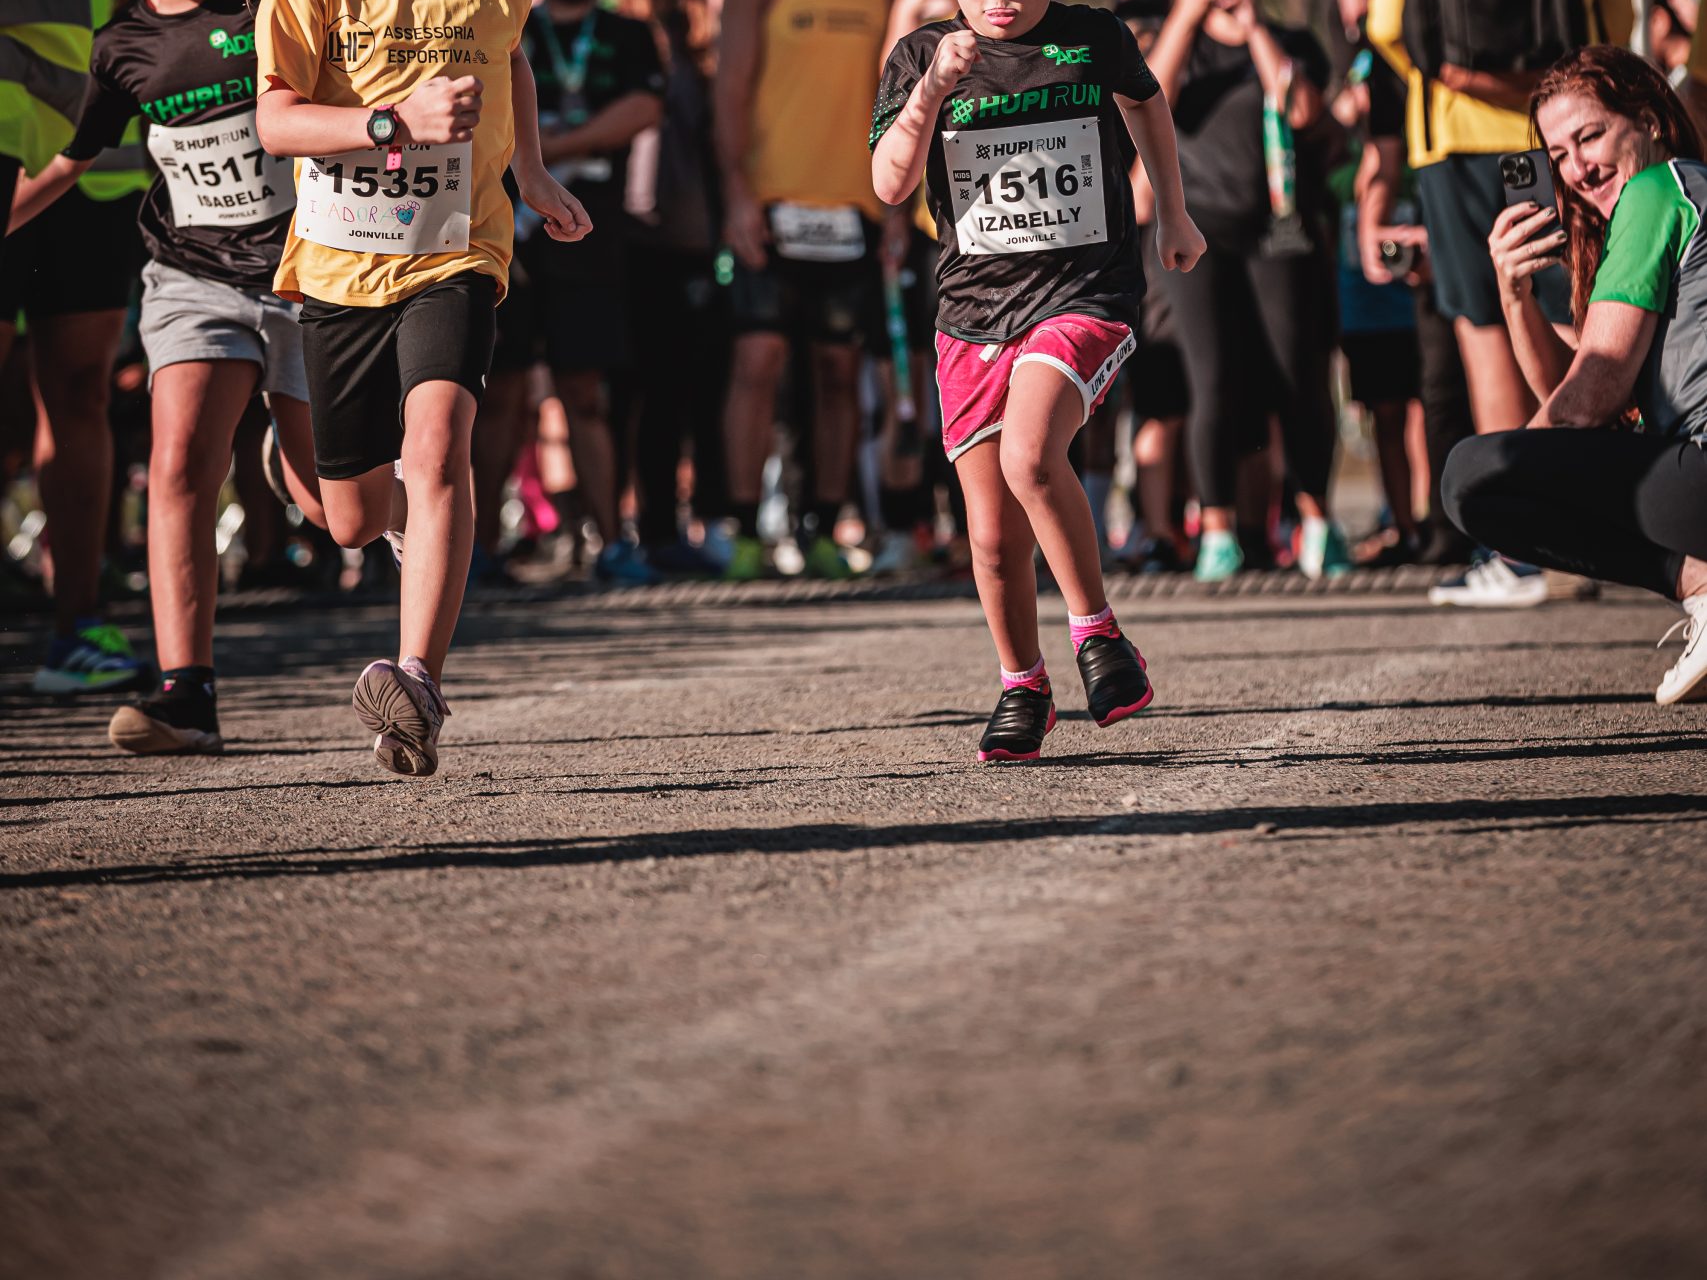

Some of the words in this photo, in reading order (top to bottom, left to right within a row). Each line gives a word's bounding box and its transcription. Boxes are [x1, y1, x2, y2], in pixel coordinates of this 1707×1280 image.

[383, 26, 475, 41] ASSESSORIA
[387, 49, 471, 64] ESPORTIVA
[1044, 44, 1059, 56] 50
[1055, 47, 1093, 65] ADE
[154, 82, 225, 121] HUPI
[979, 88, 1049, 118] HUPI
[1055, 84, 1101, 108] RUN
[187, 135, 220, 151] HUPI
[222, 127, 251, 144] RUN
[993, 140, 1034, 157] HUPI
[1036, 136, 1067, 152] RUN
[182, 148, 267, 187] 1517
[954, 171, 971, 180] KIDS
[326, 162, 439, 199] 1535
[974, 163, 1079, 205] 1516
[198, 184, 276, 208] ISABELA
[978, 206, 1082, 232] IZABELLY
[348, 229, 405, 240] JOINVILLE
[1005, 232, 1057, 245] JOINVILLE
[1091, 369, 1106, 395] LOVE
[1116, 339, 1133, 364] LOVE
